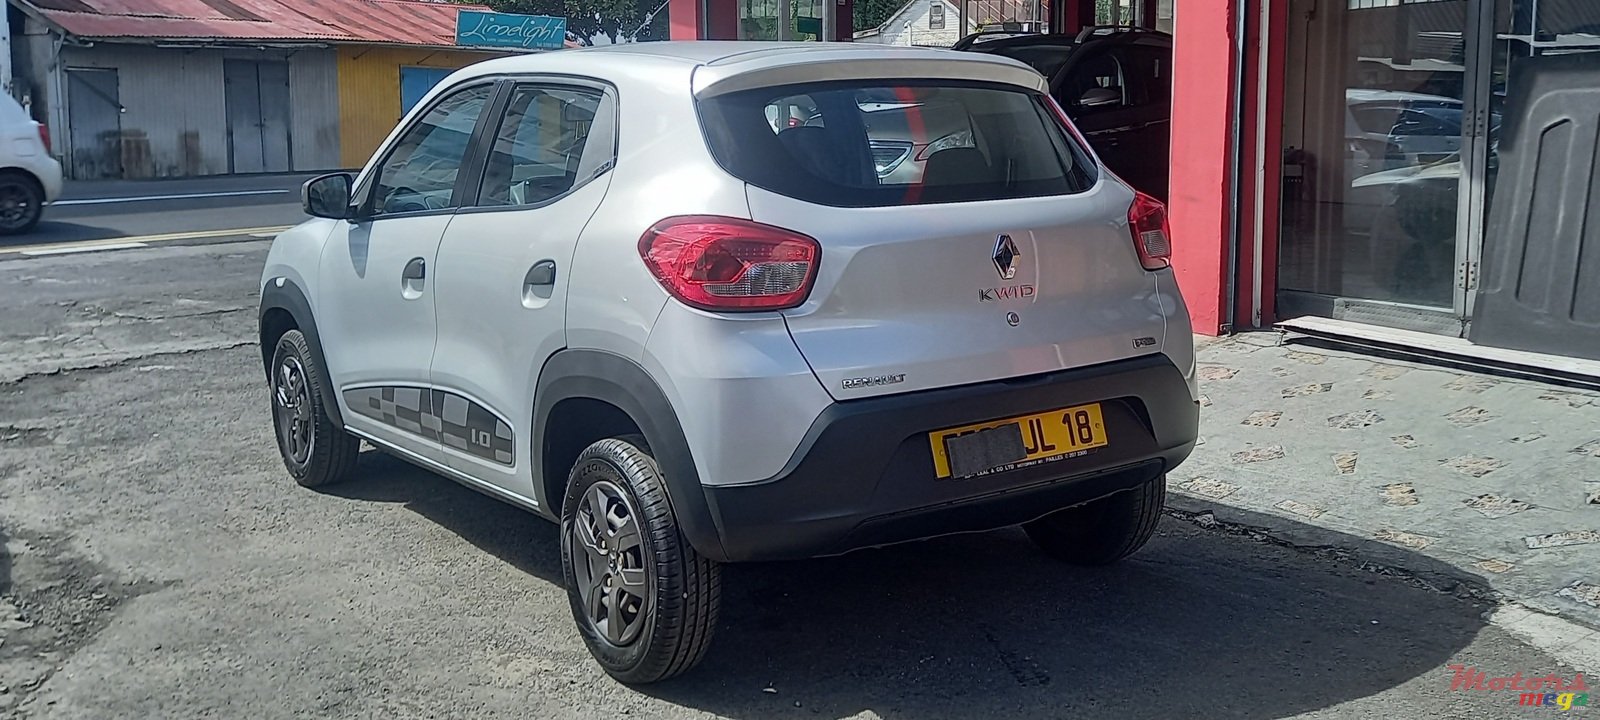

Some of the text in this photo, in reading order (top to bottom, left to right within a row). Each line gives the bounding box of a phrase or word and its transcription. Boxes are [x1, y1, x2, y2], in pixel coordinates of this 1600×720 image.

[460, 14, 563, 46] Limelight
[979, 284, 1035, 302] KWID
[842, 373, 906, 389] RENAULT
[471, 428, 491, 448] 1.0
[1025, 410, 1056, 454] JL
[1062, 410, 1093, 446] 18
